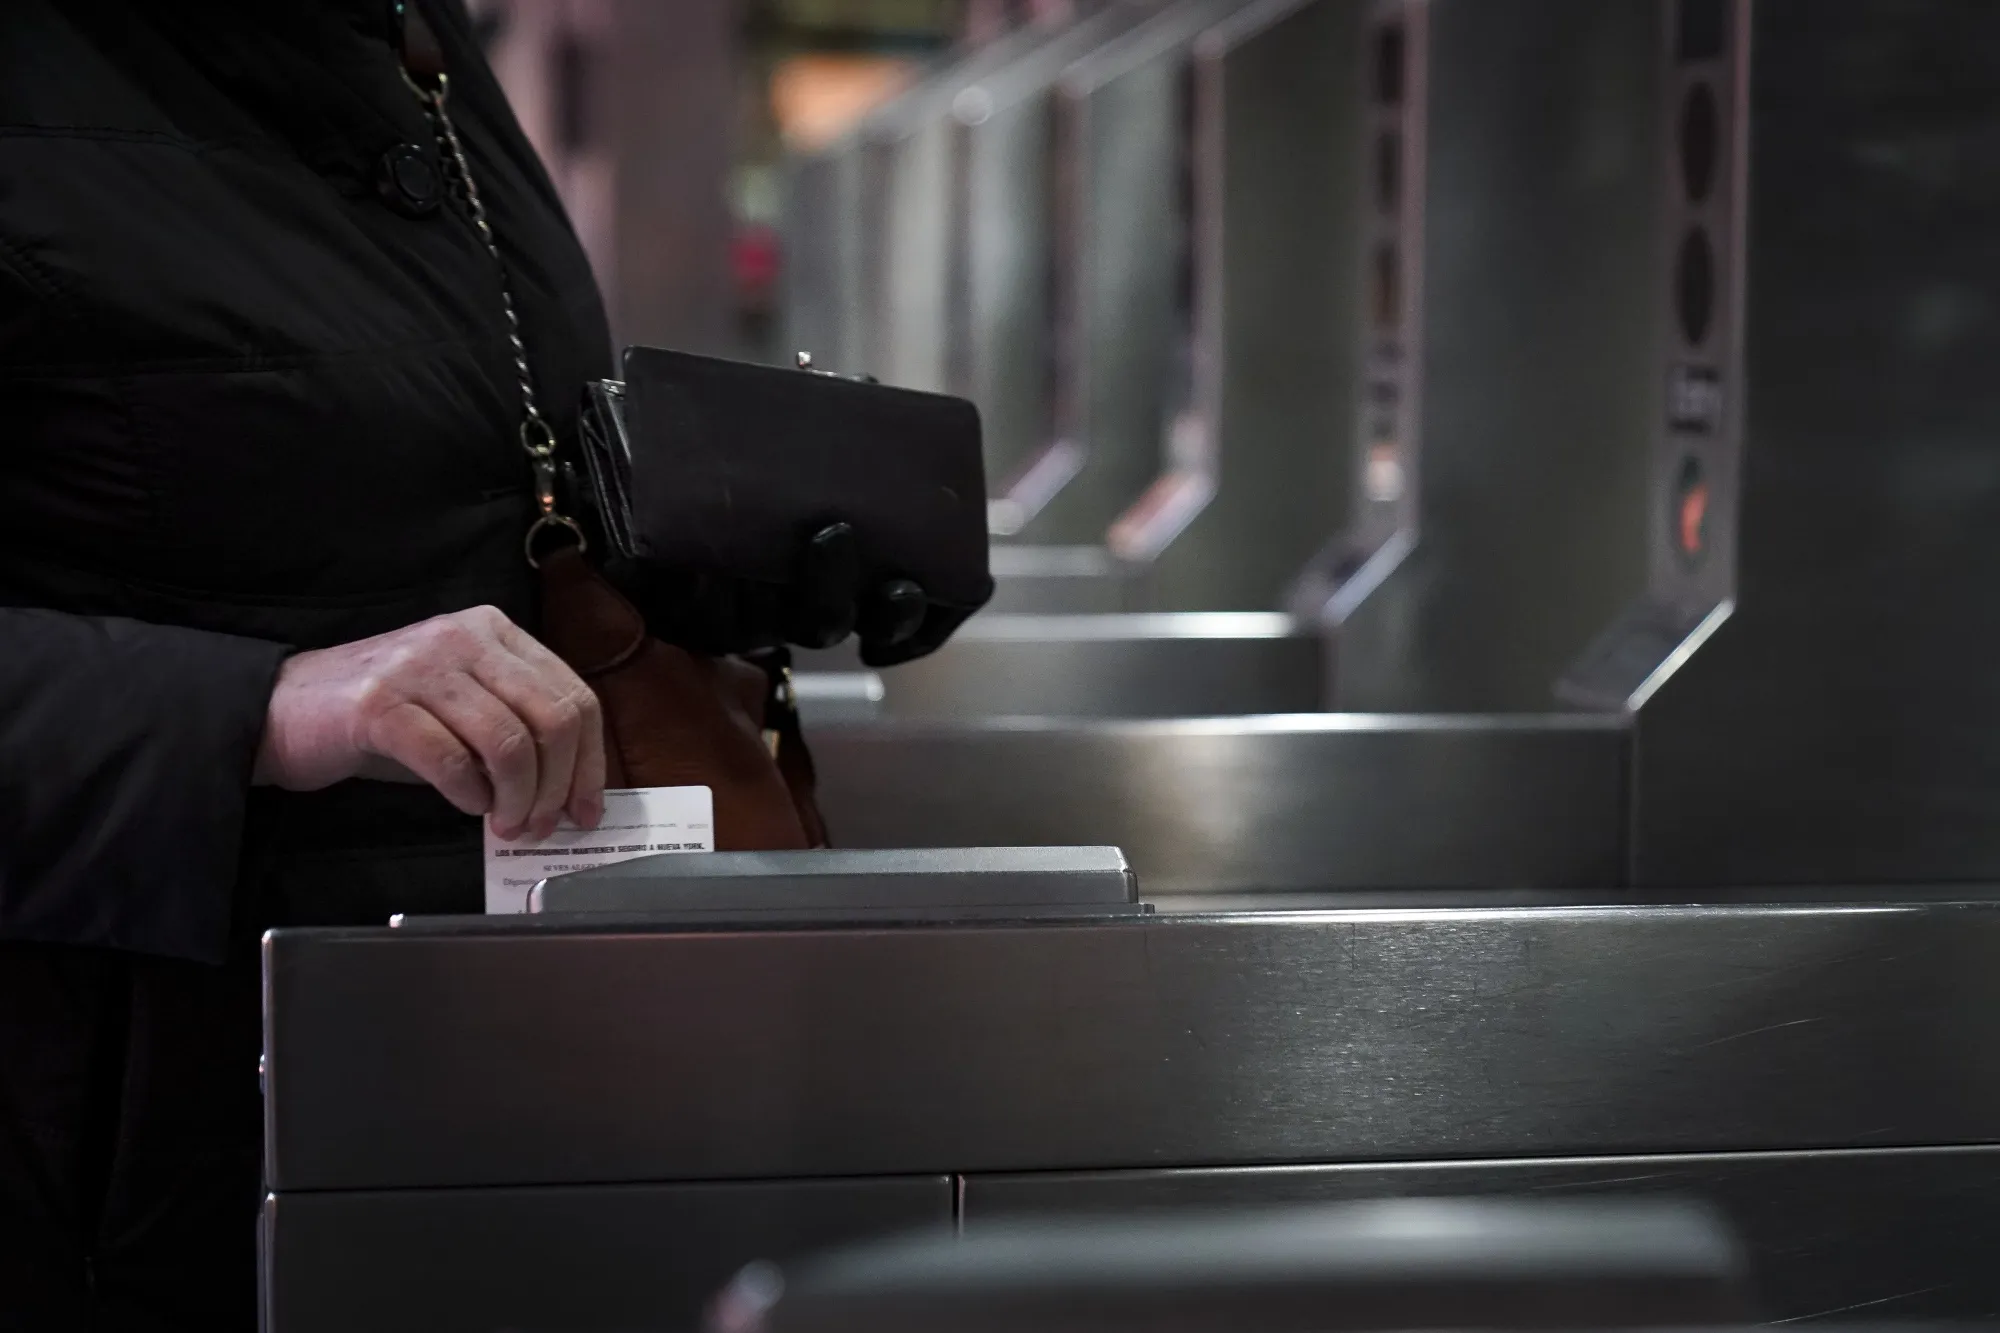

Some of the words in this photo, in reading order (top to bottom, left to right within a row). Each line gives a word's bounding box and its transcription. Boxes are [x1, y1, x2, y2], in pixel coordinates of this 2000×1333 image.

[495, 849, 510, 857] LOS
[617, 844, 647, 853] SEGURO
[656, 843, 681, 851] NUEVA
